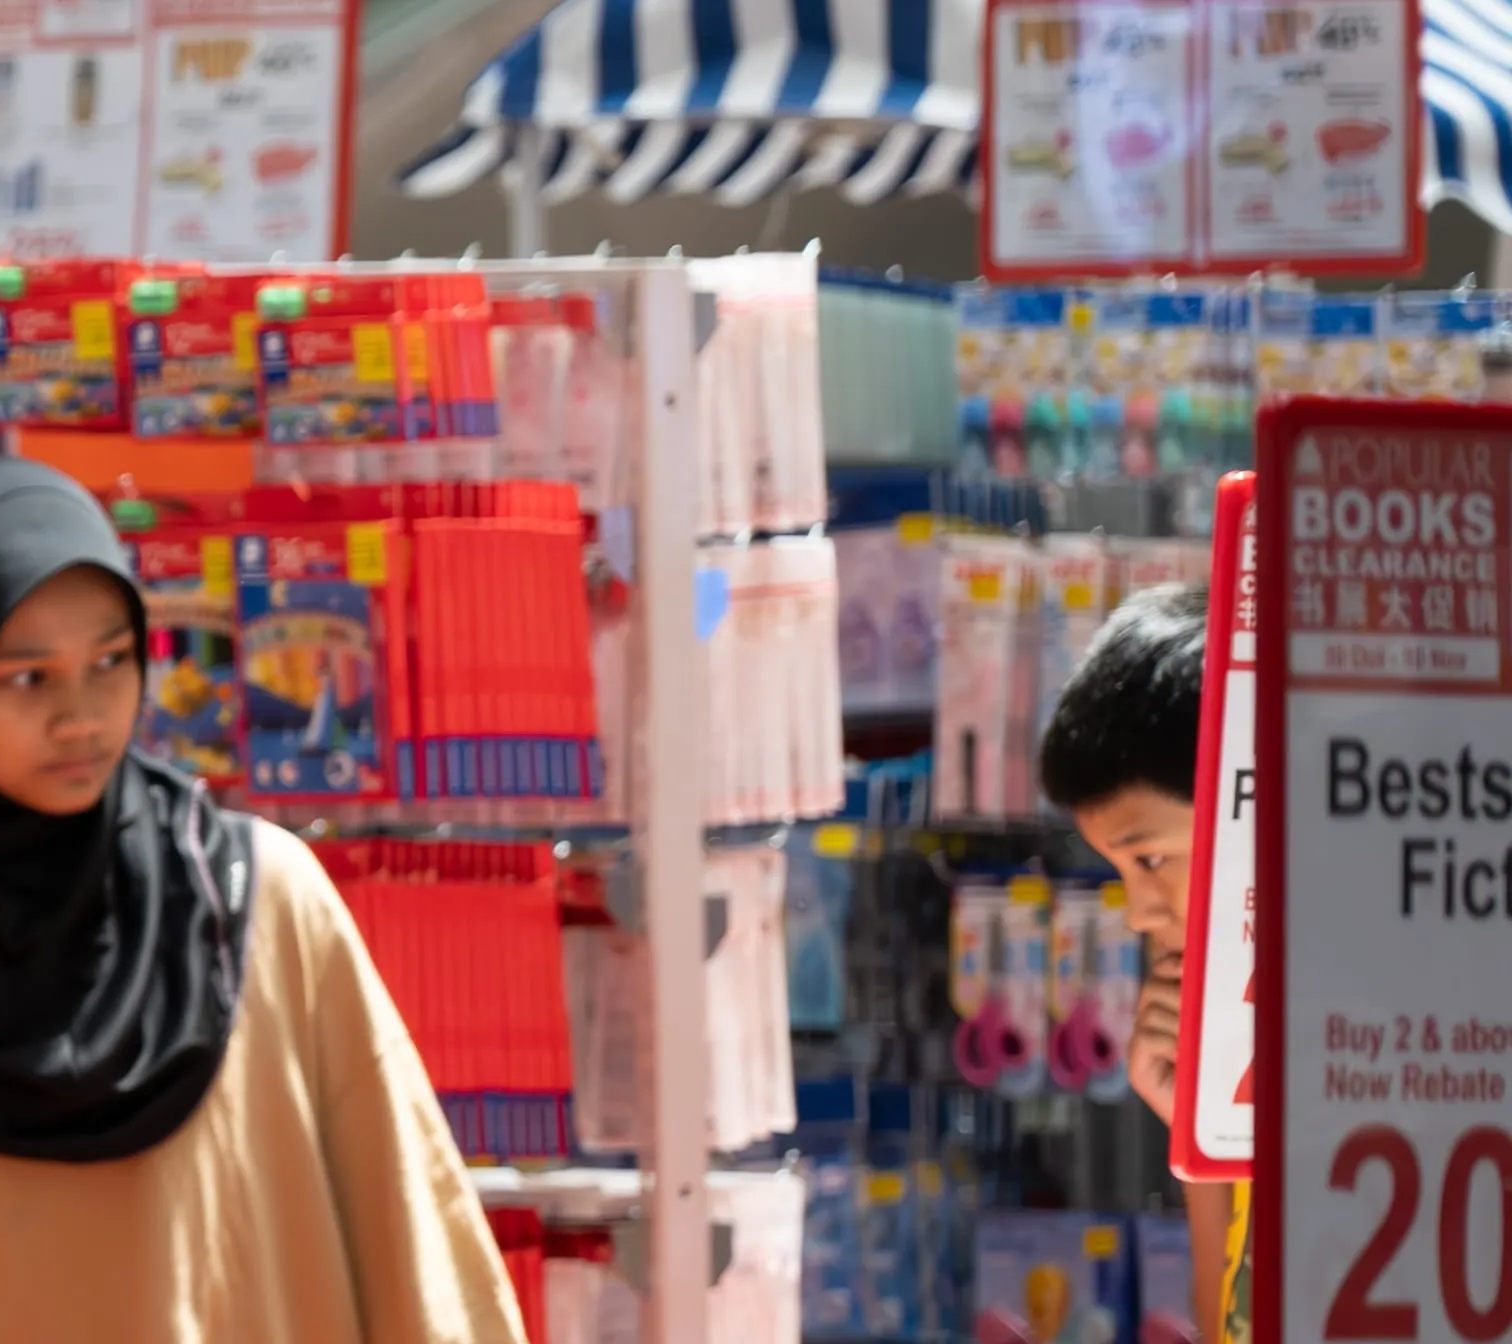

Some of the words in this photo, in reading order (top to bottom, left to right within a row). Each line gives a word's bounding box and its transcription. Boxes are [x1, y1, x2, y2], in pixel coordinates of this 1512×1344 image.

[1293, 486, 1496, 547] BOOKS
[1294, 545, 1497, 583] CLEARANCE
[1324, 1013, 1385, 1063] Buy
[1394, 1015, 1413, 1053] 2
[1324, 1064, 1391, 1102] Now
[1401, 1064, 1506, 1102] Rebate
